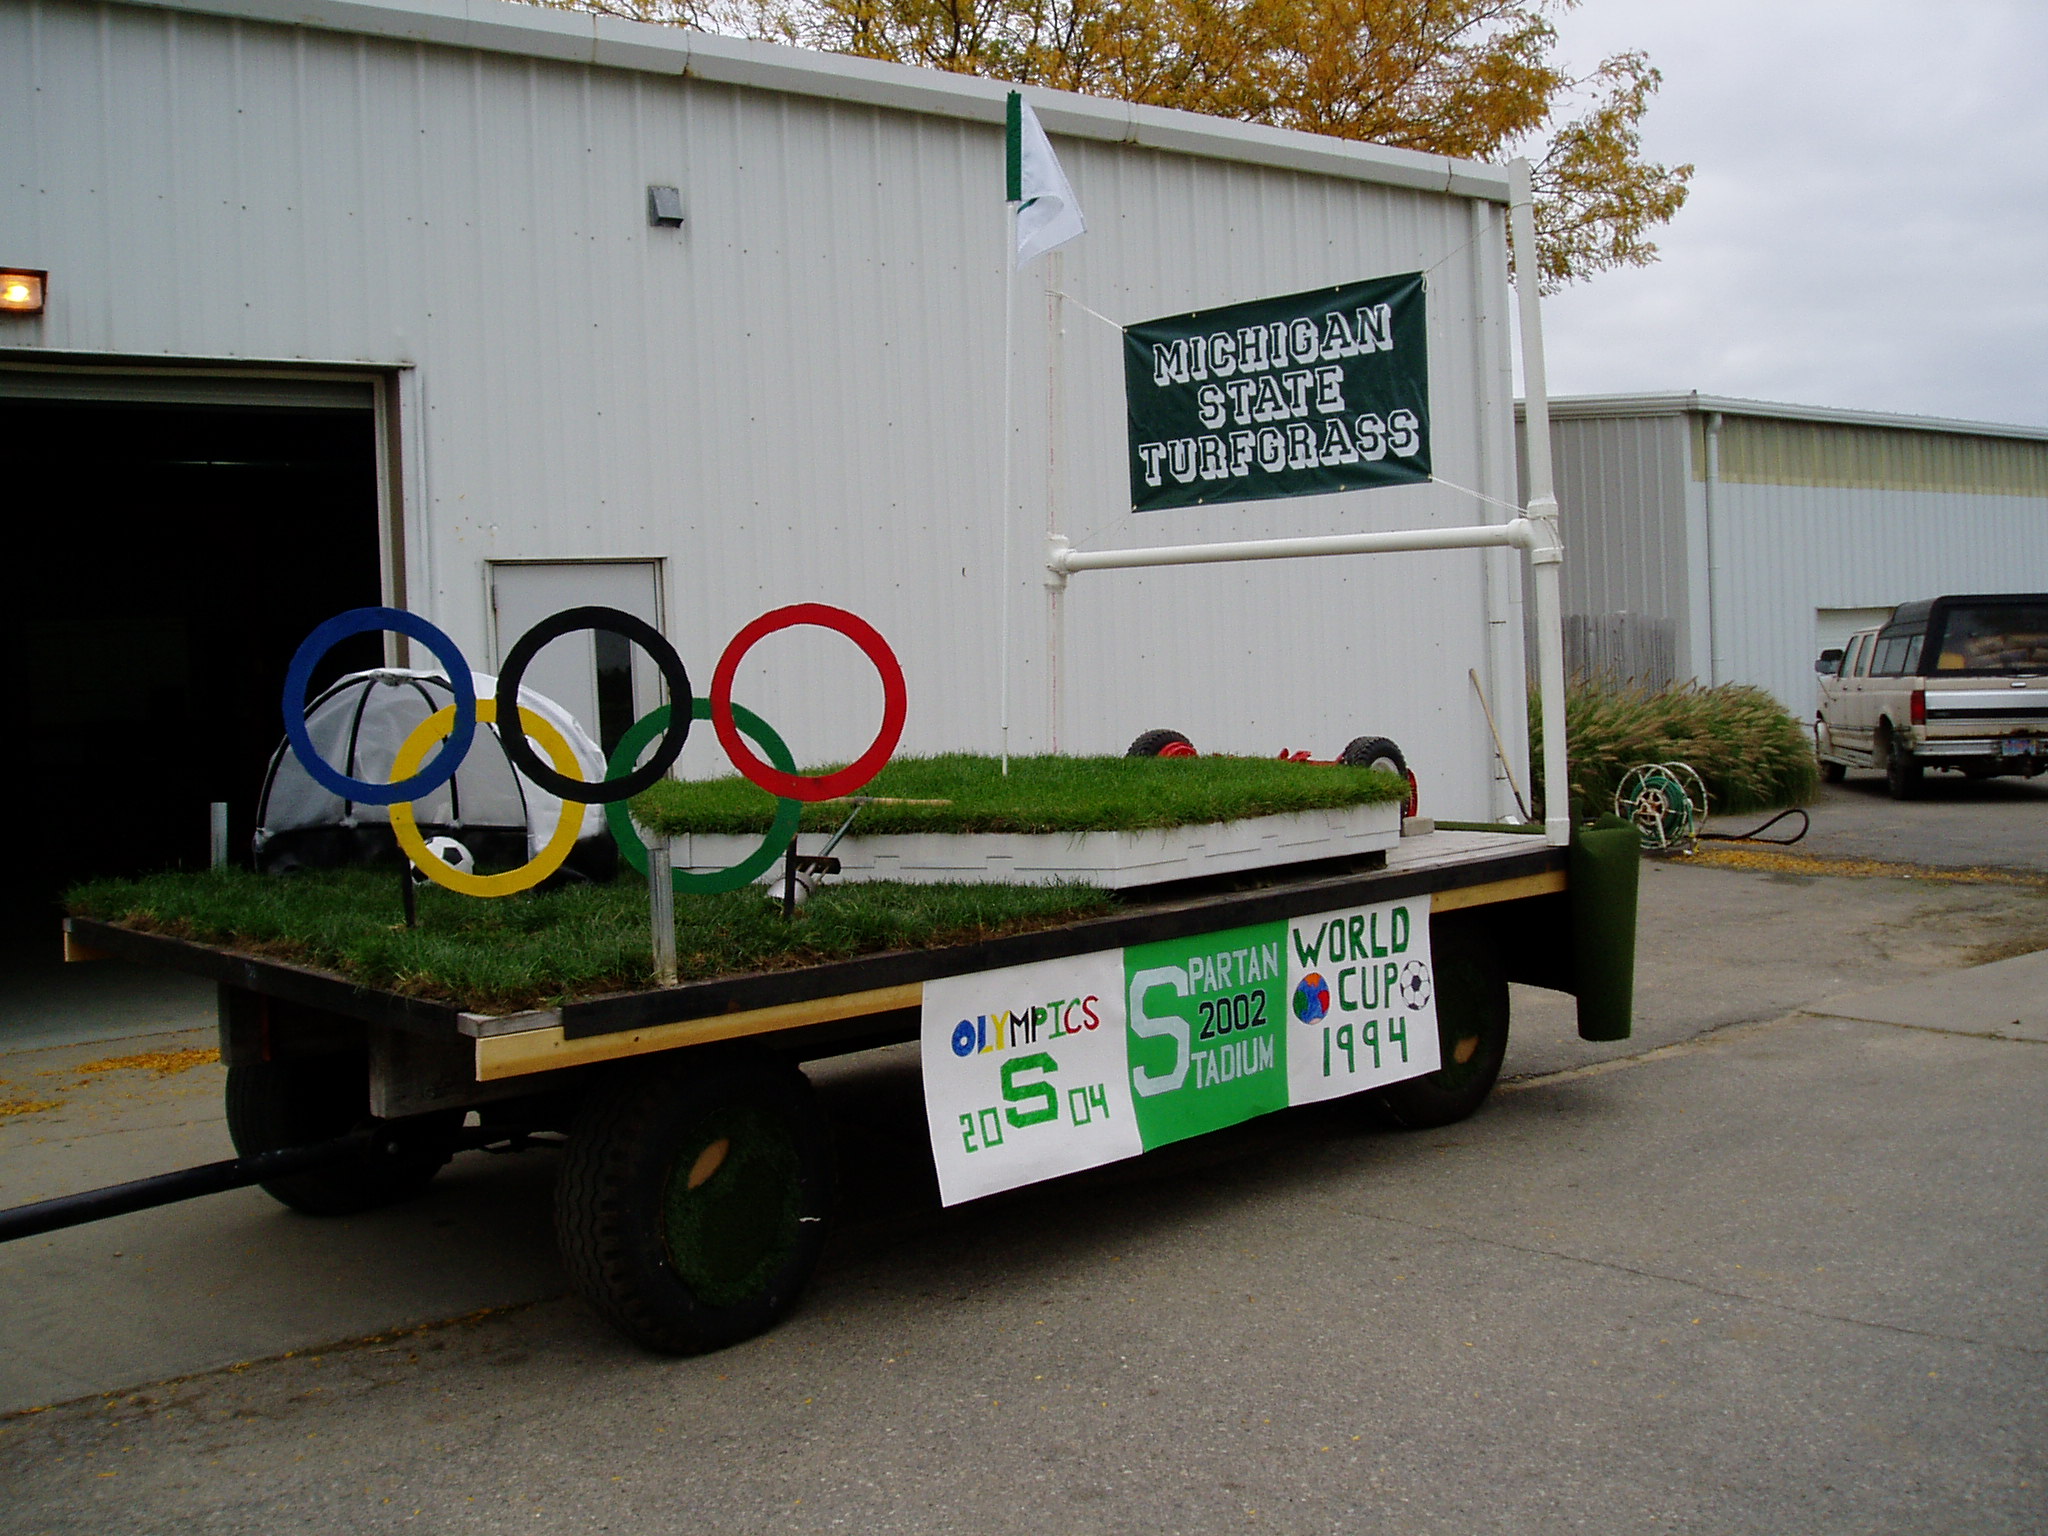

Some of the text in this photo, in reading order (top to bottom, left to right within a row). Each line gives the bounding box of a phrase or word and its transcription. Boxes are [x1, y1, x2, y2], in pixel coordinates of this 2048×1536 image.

[1153, 303, 1393, 386] MICHIGAN
[1198, 365, 1345, 429] STATE
[1139, 409, 1419, 486] TURFGRASS
[1293, 906, 1409, 968] WORLD
[1199, 989, 1267, 1040] 2002
[1338, 962, 1398, 1011] CUP
[951, 995, 1100, 1057] OLYMPICS
[1323, 1016, 1408, 1077] 1994
[1001, 1052, 1058, 1128] S
